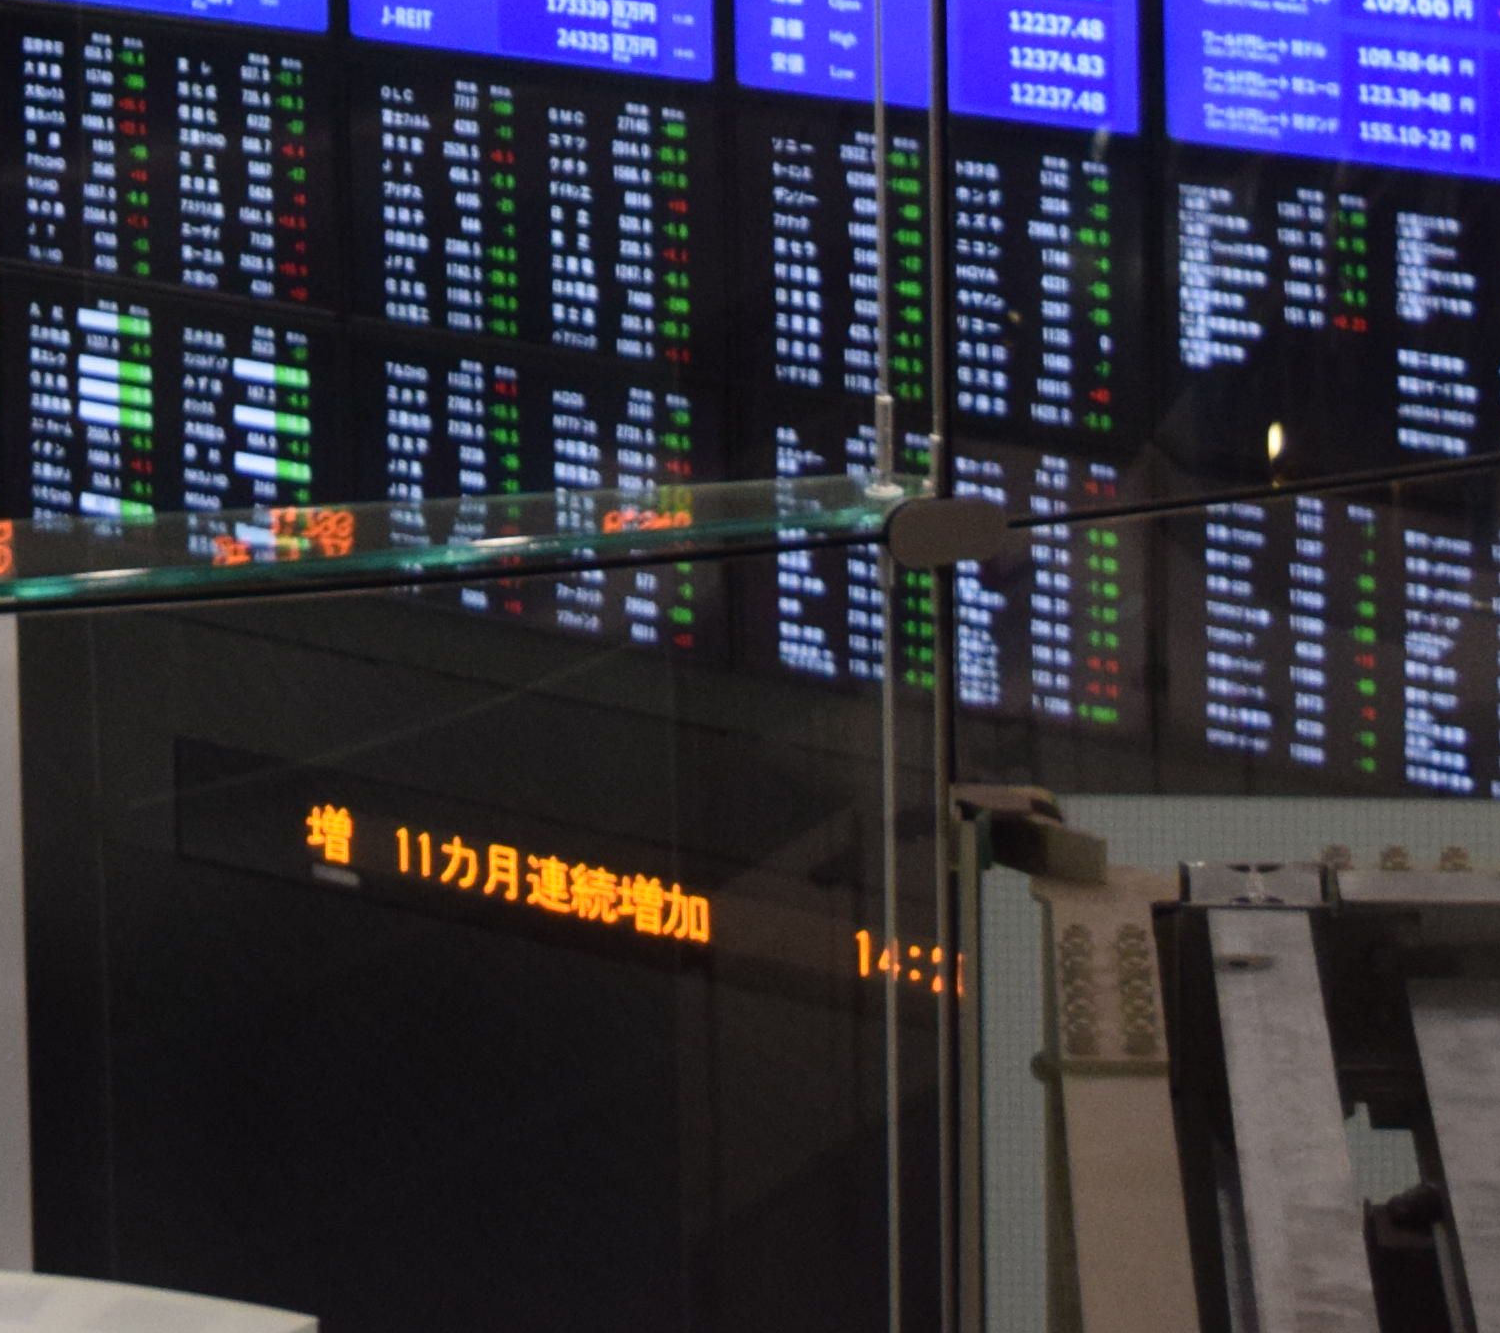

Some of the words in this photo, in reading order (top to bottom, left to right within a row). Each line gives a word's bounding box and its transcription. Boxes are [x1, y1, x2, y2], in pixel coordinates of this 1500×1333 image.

[382, 6, 432, 31] J-REIT
[306, 805, 354, 865] 増
[396, 827, 710, 944] 11カ月連続増加
